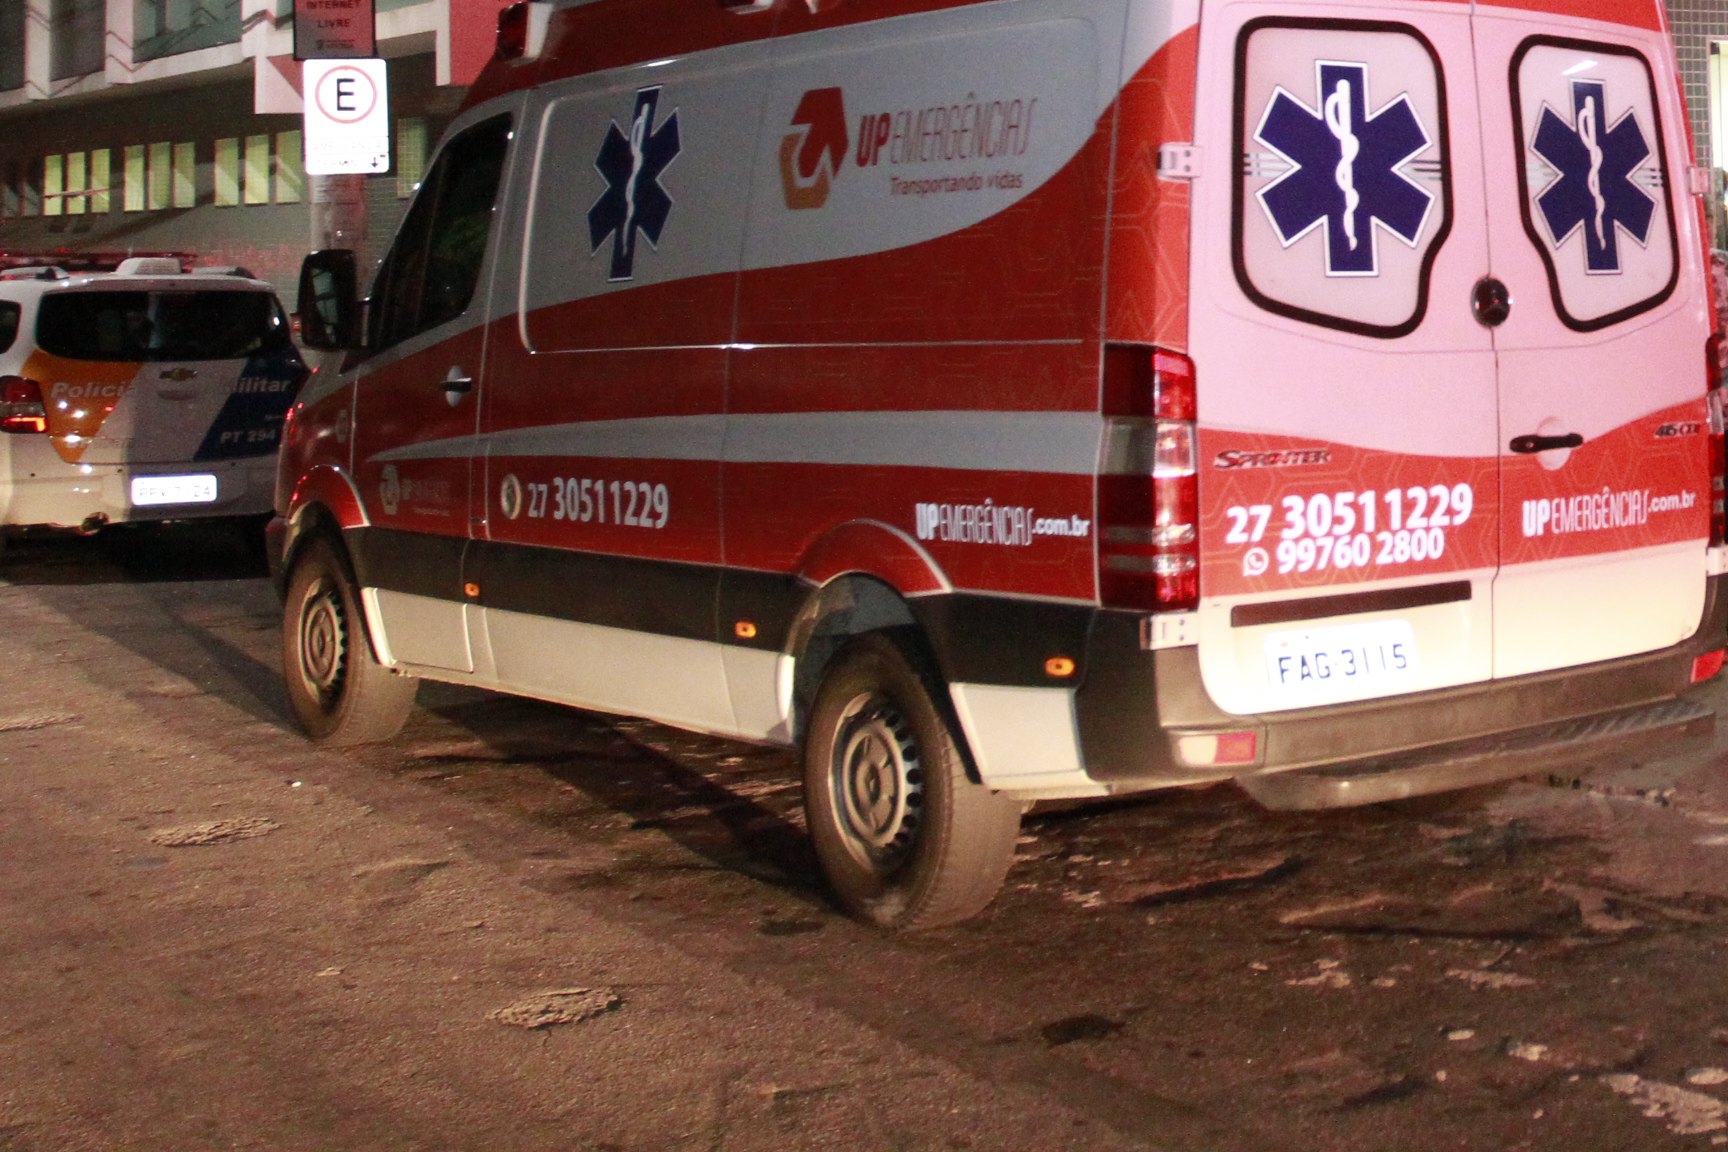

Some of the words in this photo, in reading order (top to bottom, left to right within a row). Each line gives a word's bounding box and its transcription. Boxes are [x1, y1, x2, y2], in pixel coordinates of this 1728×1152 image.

[306, 0, 361, 9] INTERNET
[336, 78, 356, 111] E
[527, 483, 548, 518] 27
[1226, 504, 1272, 543] 27
[1276, 533, 1371, 574] 99760
[1375, 527, 1444, 565] 2800
